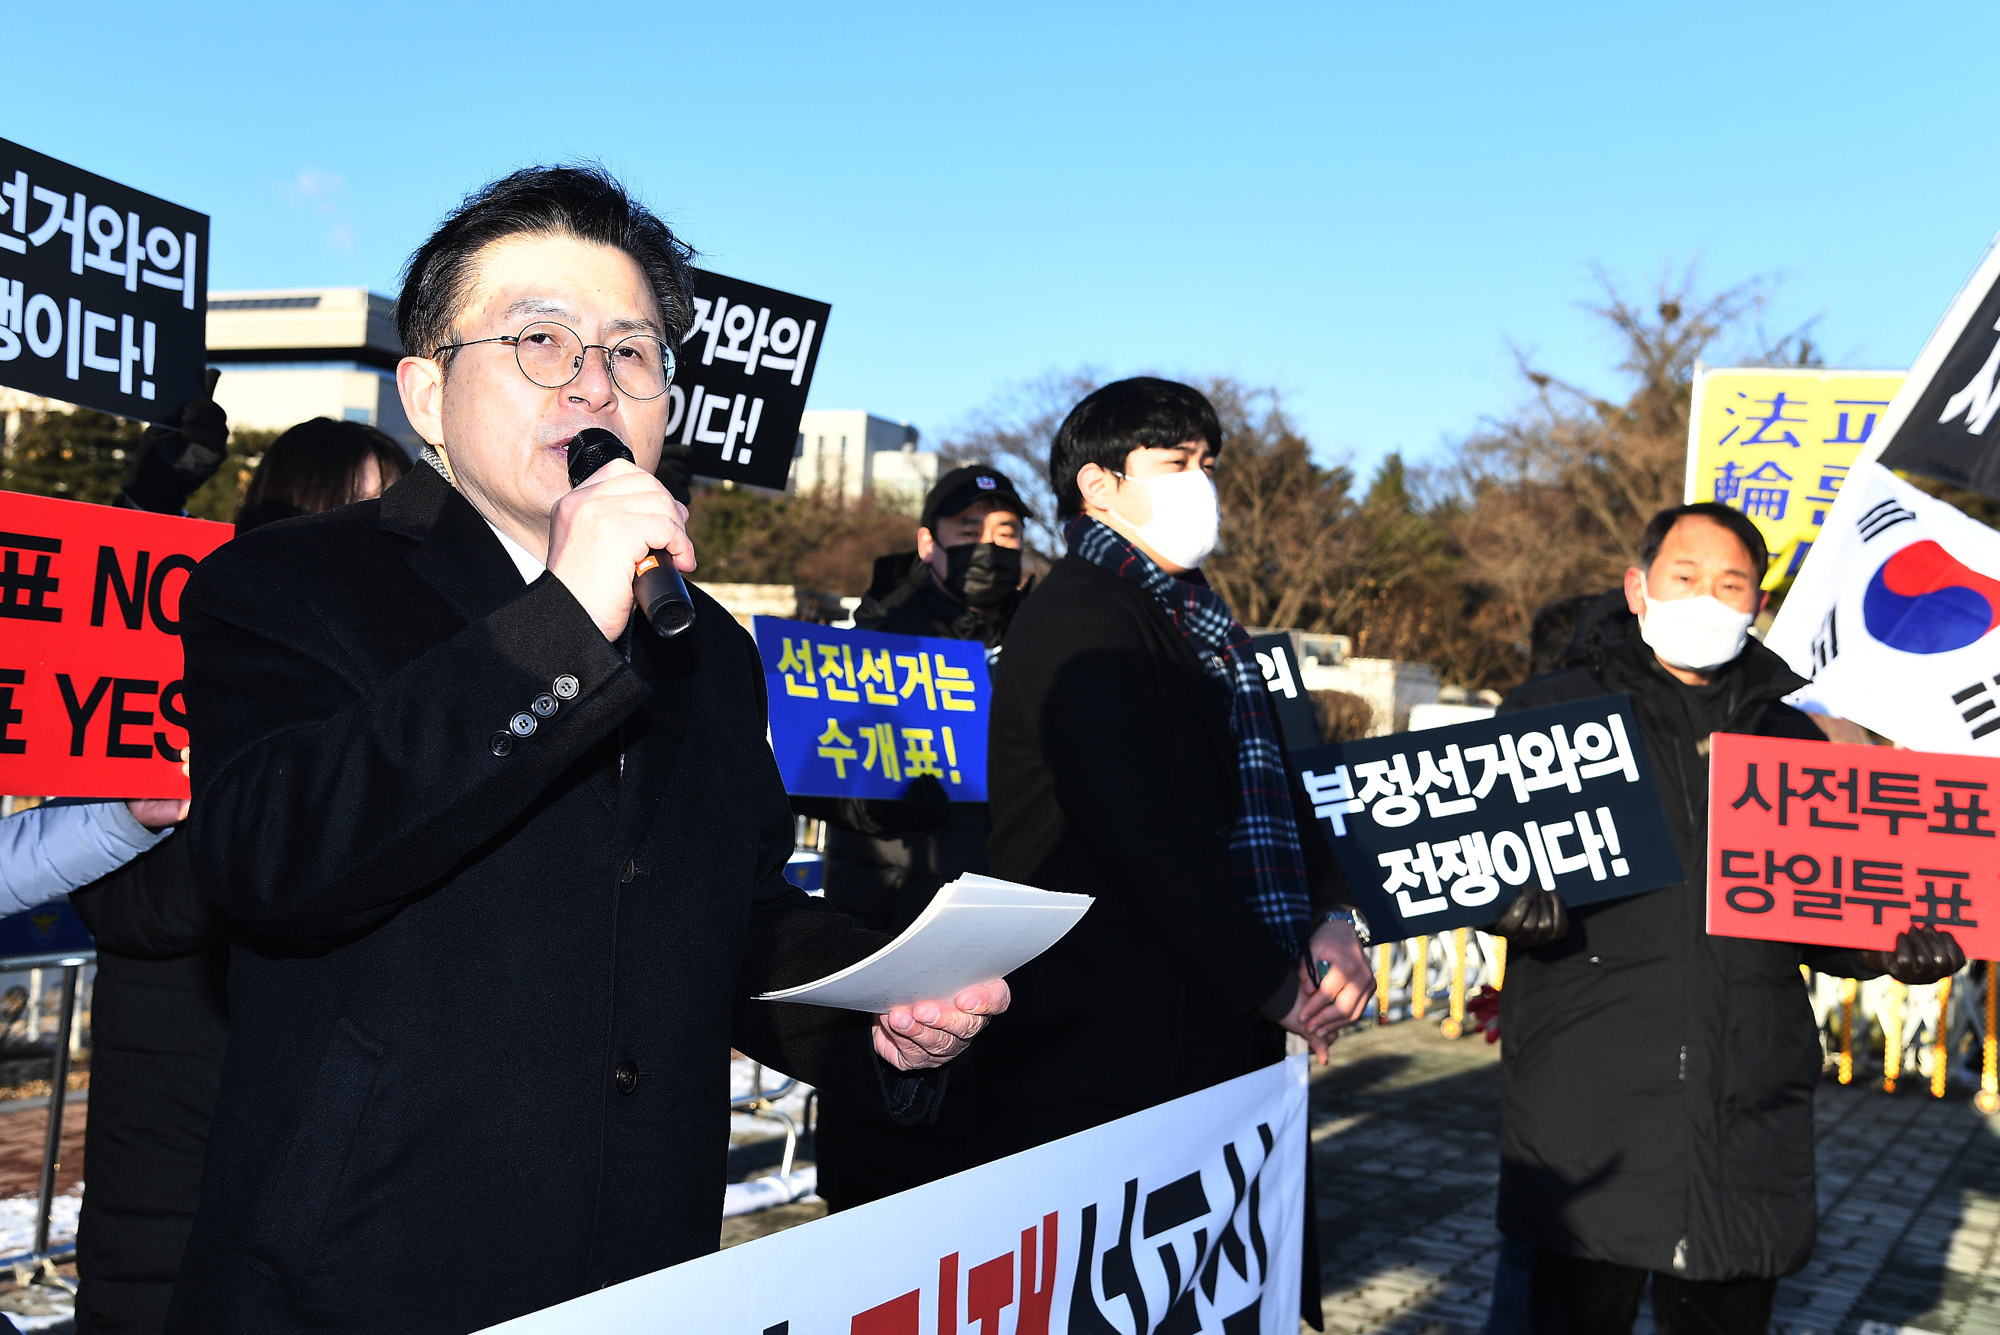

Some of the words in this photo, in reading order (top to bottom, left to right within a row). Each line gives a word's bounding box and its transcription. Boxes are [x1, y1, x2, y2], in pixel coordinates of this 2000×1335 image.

[90, 545, 199, 636] NO
[55, 672, 190, 763] YES
[777, 638, 976, 712] 선진선거는
[817, 718, 962, 784] 수개표!
[1301, 713, 1640, 837] 부정선거와의
[1731, 762, 1996, 838] 사전투표
[1377, 806, 1631, 919] 전쟁이다!
[1721, 849, 1978, 928] 당일투표
